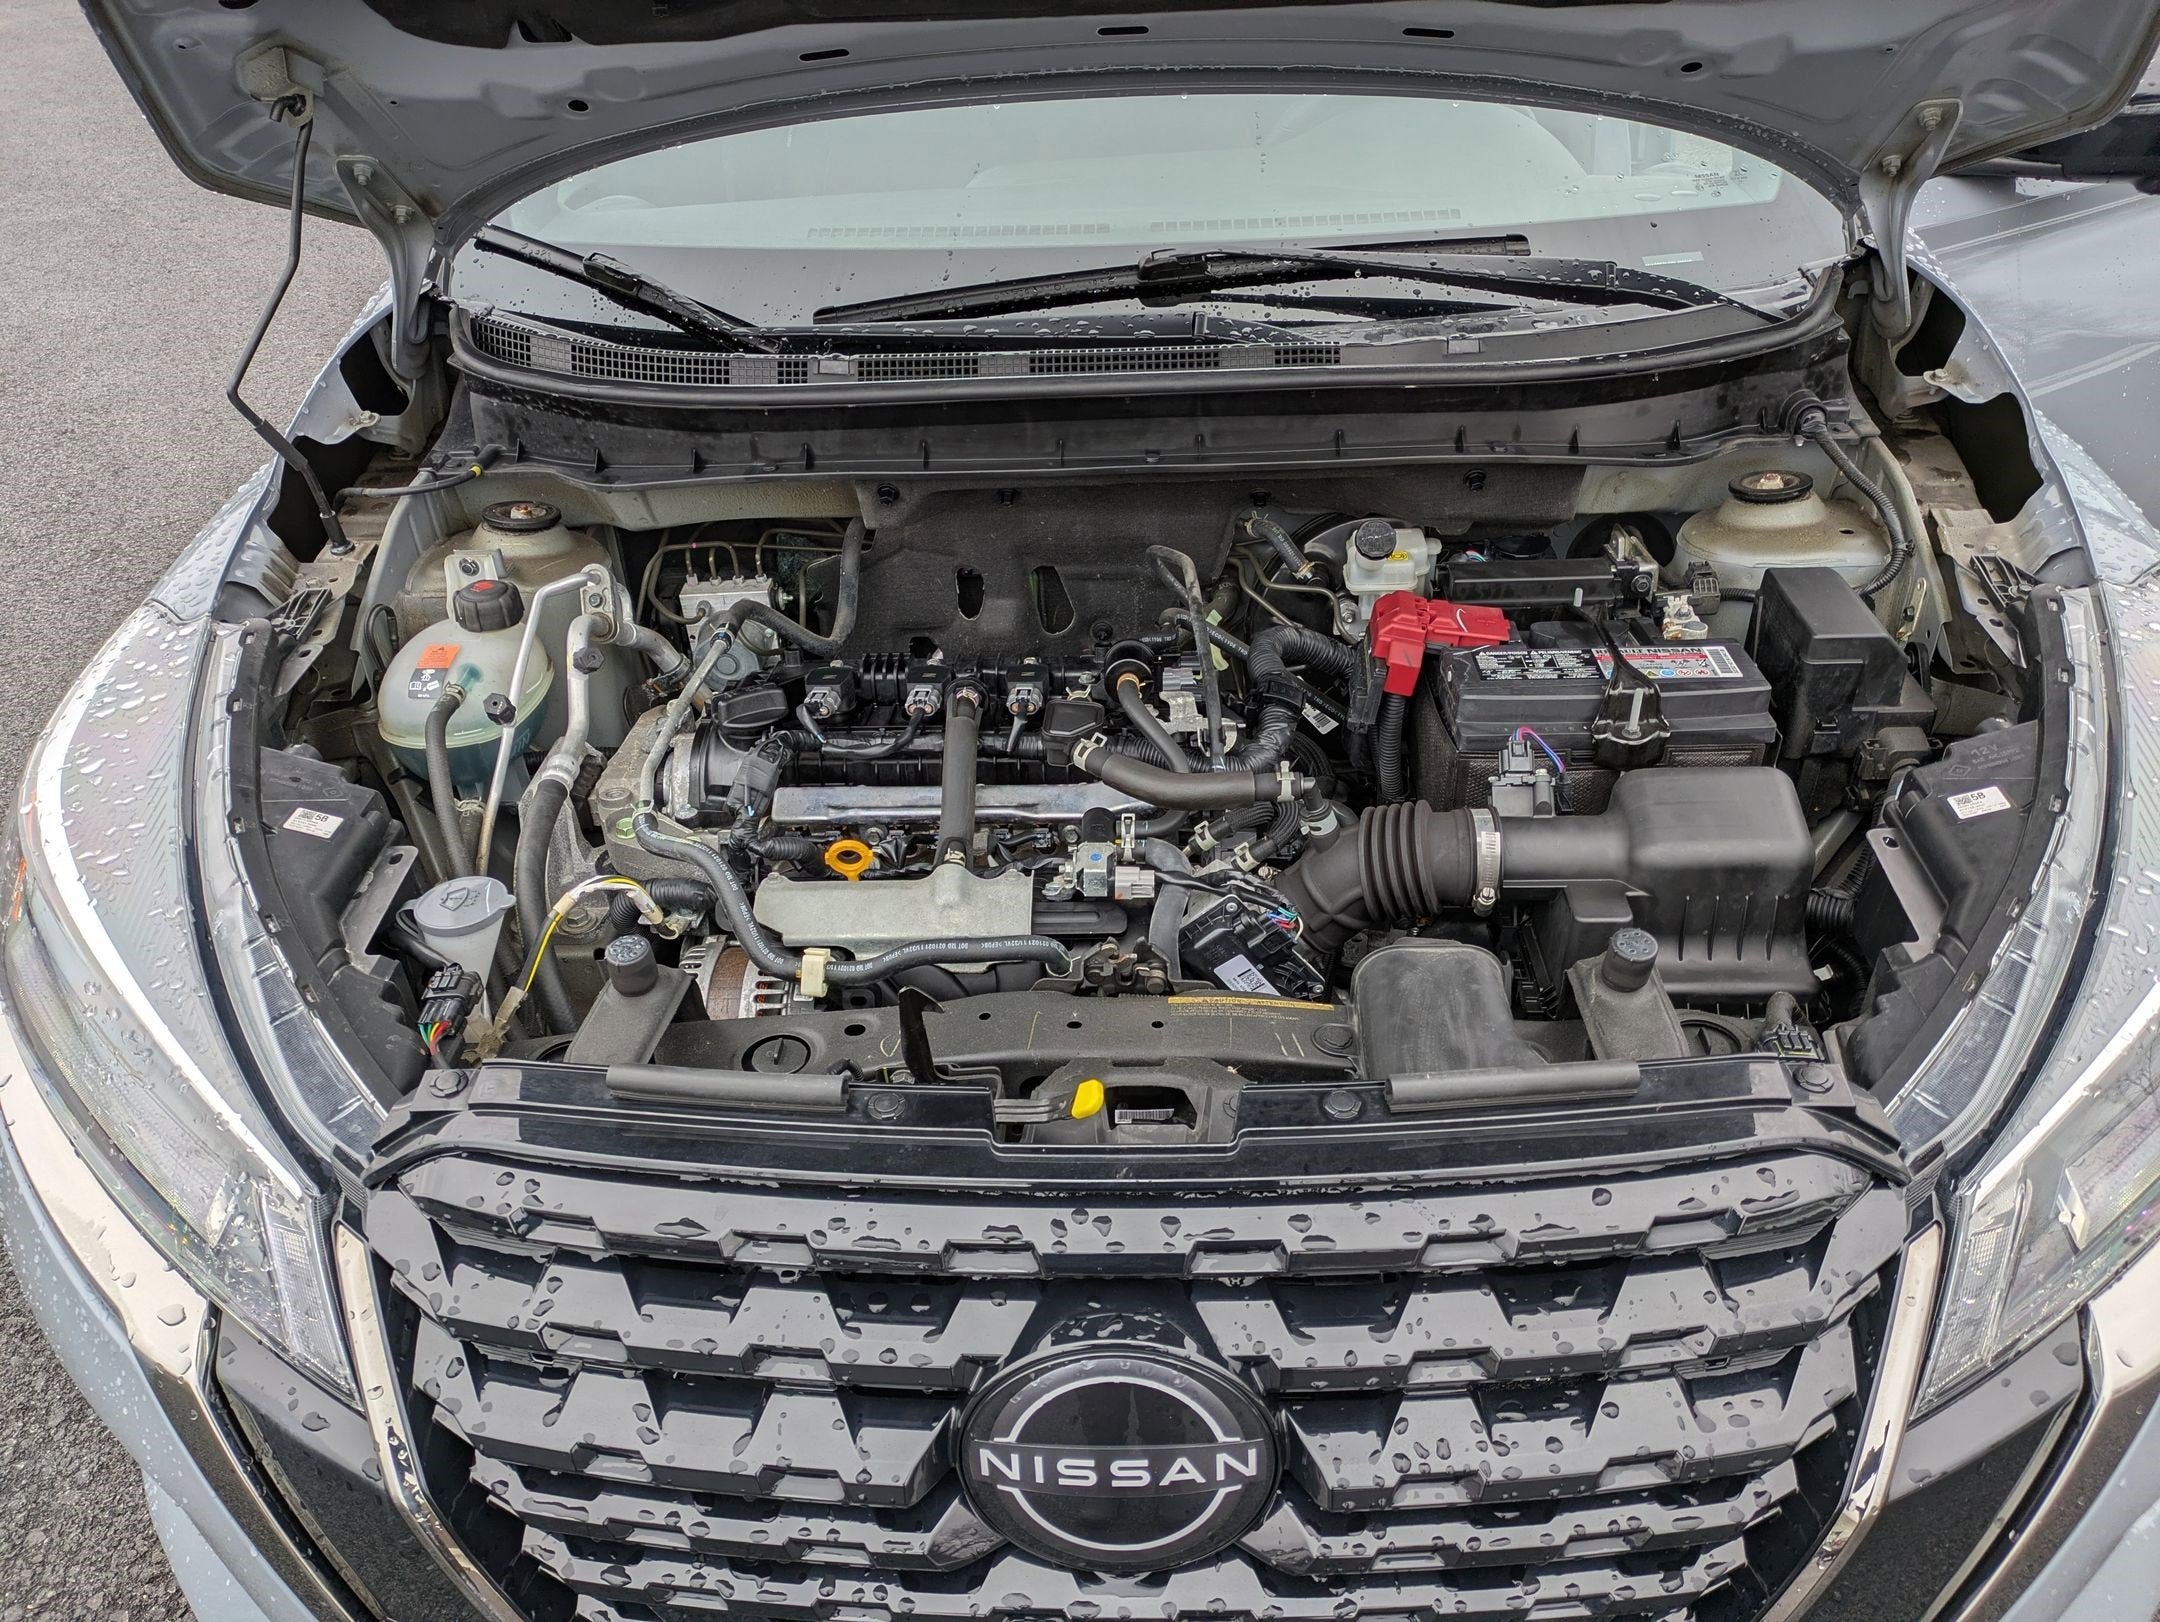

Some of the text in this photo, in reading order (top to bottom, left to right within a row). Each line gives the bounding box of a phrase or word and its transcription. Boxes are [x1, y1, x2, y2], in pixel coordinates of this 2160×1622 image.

[1970, 792, 1986, 801] 5B
[314, 813, 329, 822] 5B
[979, 1448, 1257, 1487] NISSAN
